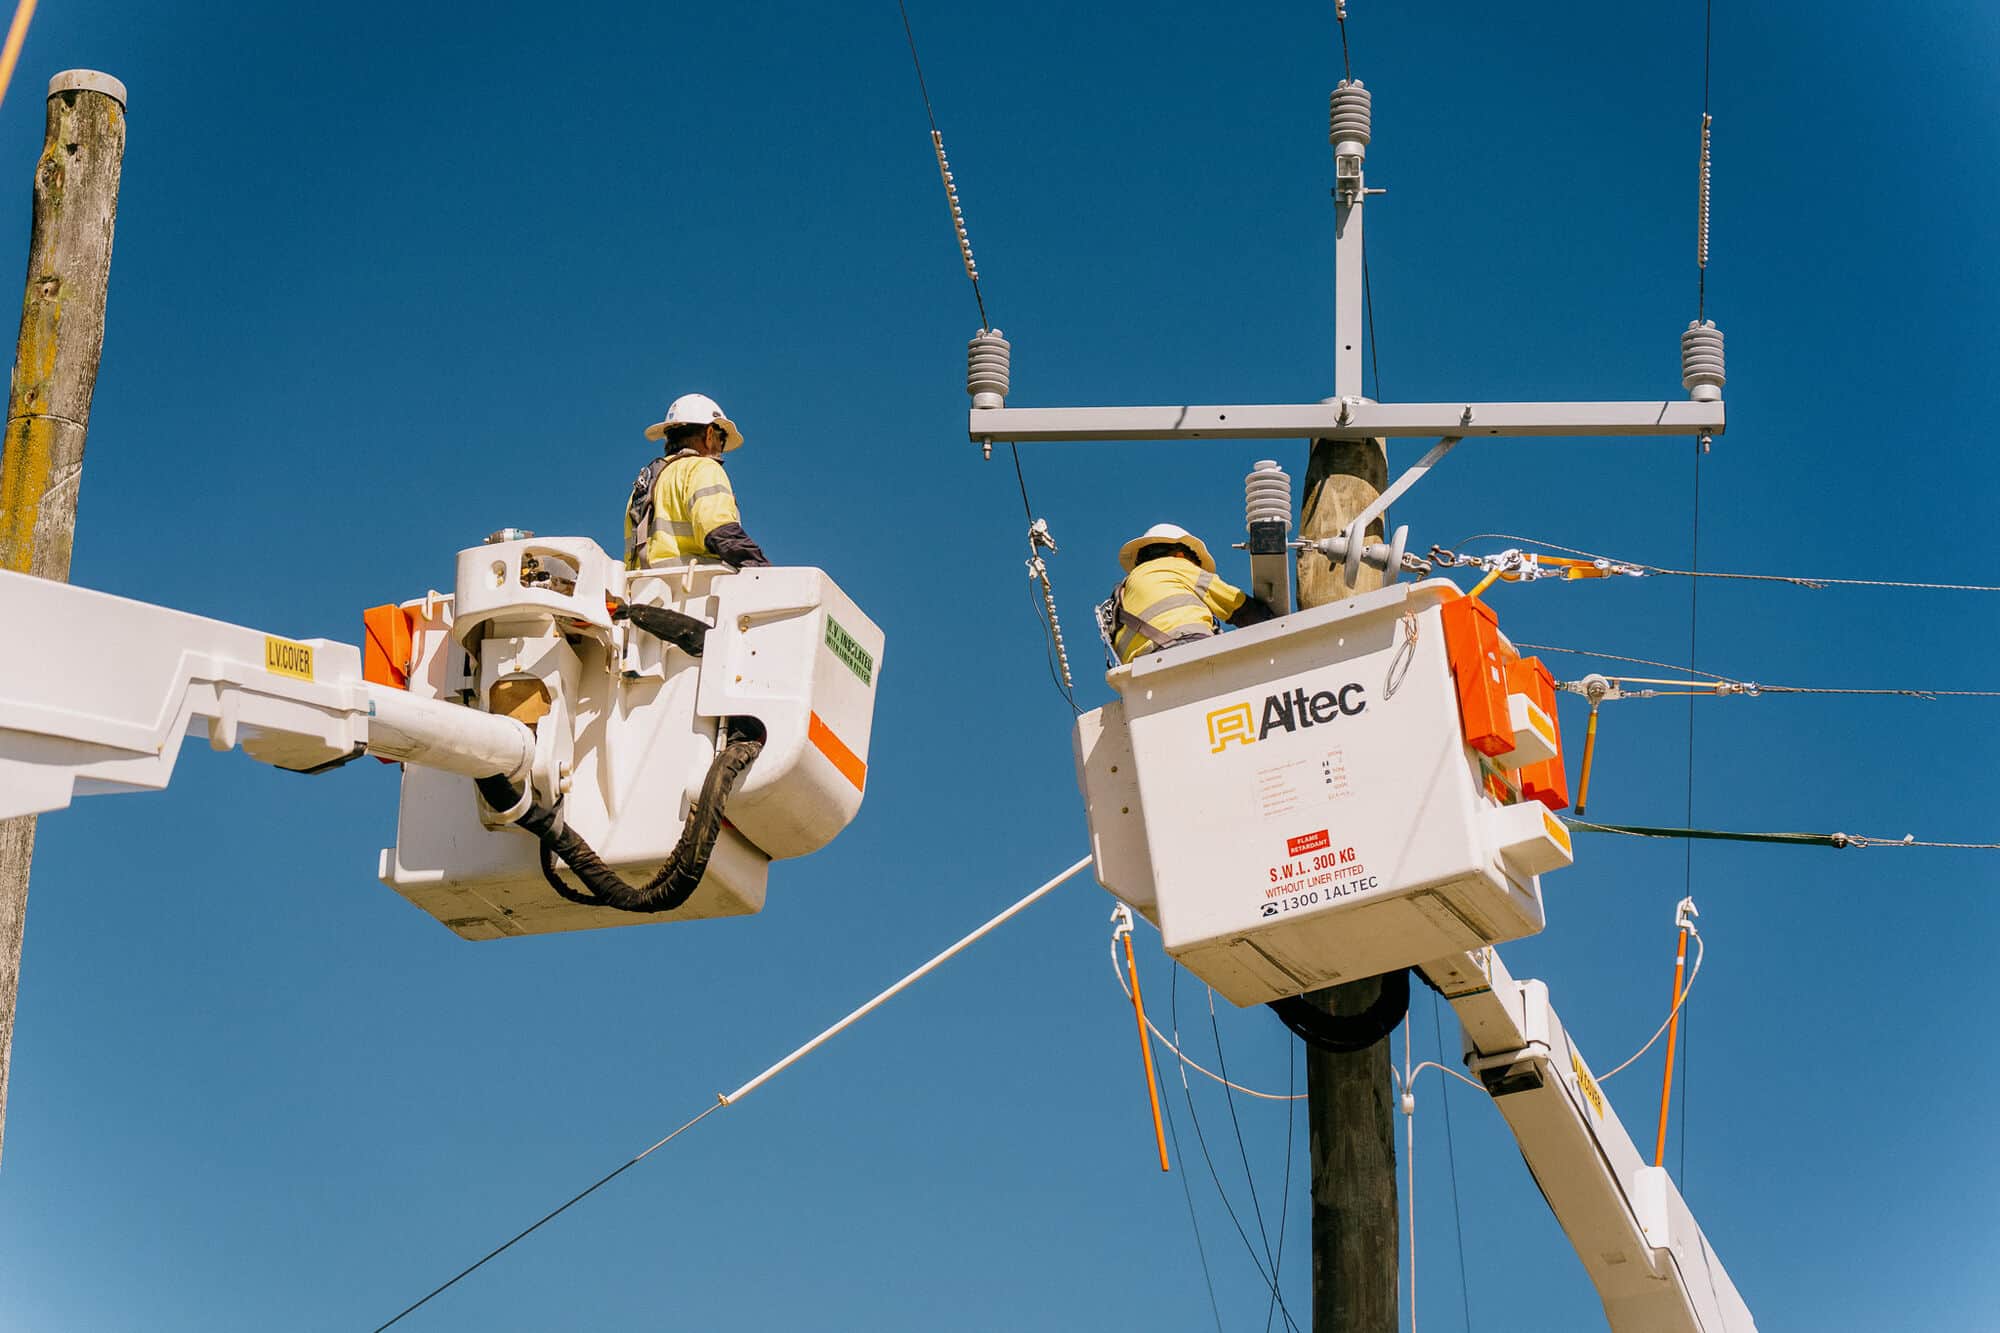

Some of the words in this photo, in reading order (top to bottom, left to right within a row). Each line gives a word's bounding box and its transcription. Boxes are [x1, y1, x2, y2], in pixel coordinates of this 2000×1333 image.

[1258, 683, 1366, 741] Altec
[1290, 839, 1328, 854] RETARDANT
[1297, 834, 1319, 844] FLAME
[1265, 880, 1305, 899] WITHOUT
[1307, 872, 1333, 888] LINER
[1334, 864, 1364, 881] FITTED
[1269, 861, 1311, 883] S.W.L.
[1313, 852, 1336, 871] 300
[1339, 847, 1356, 864] KG
[1282, 892, 1319, 912] 1300
[1325, 876, 1378, 900] 1ALTEC
